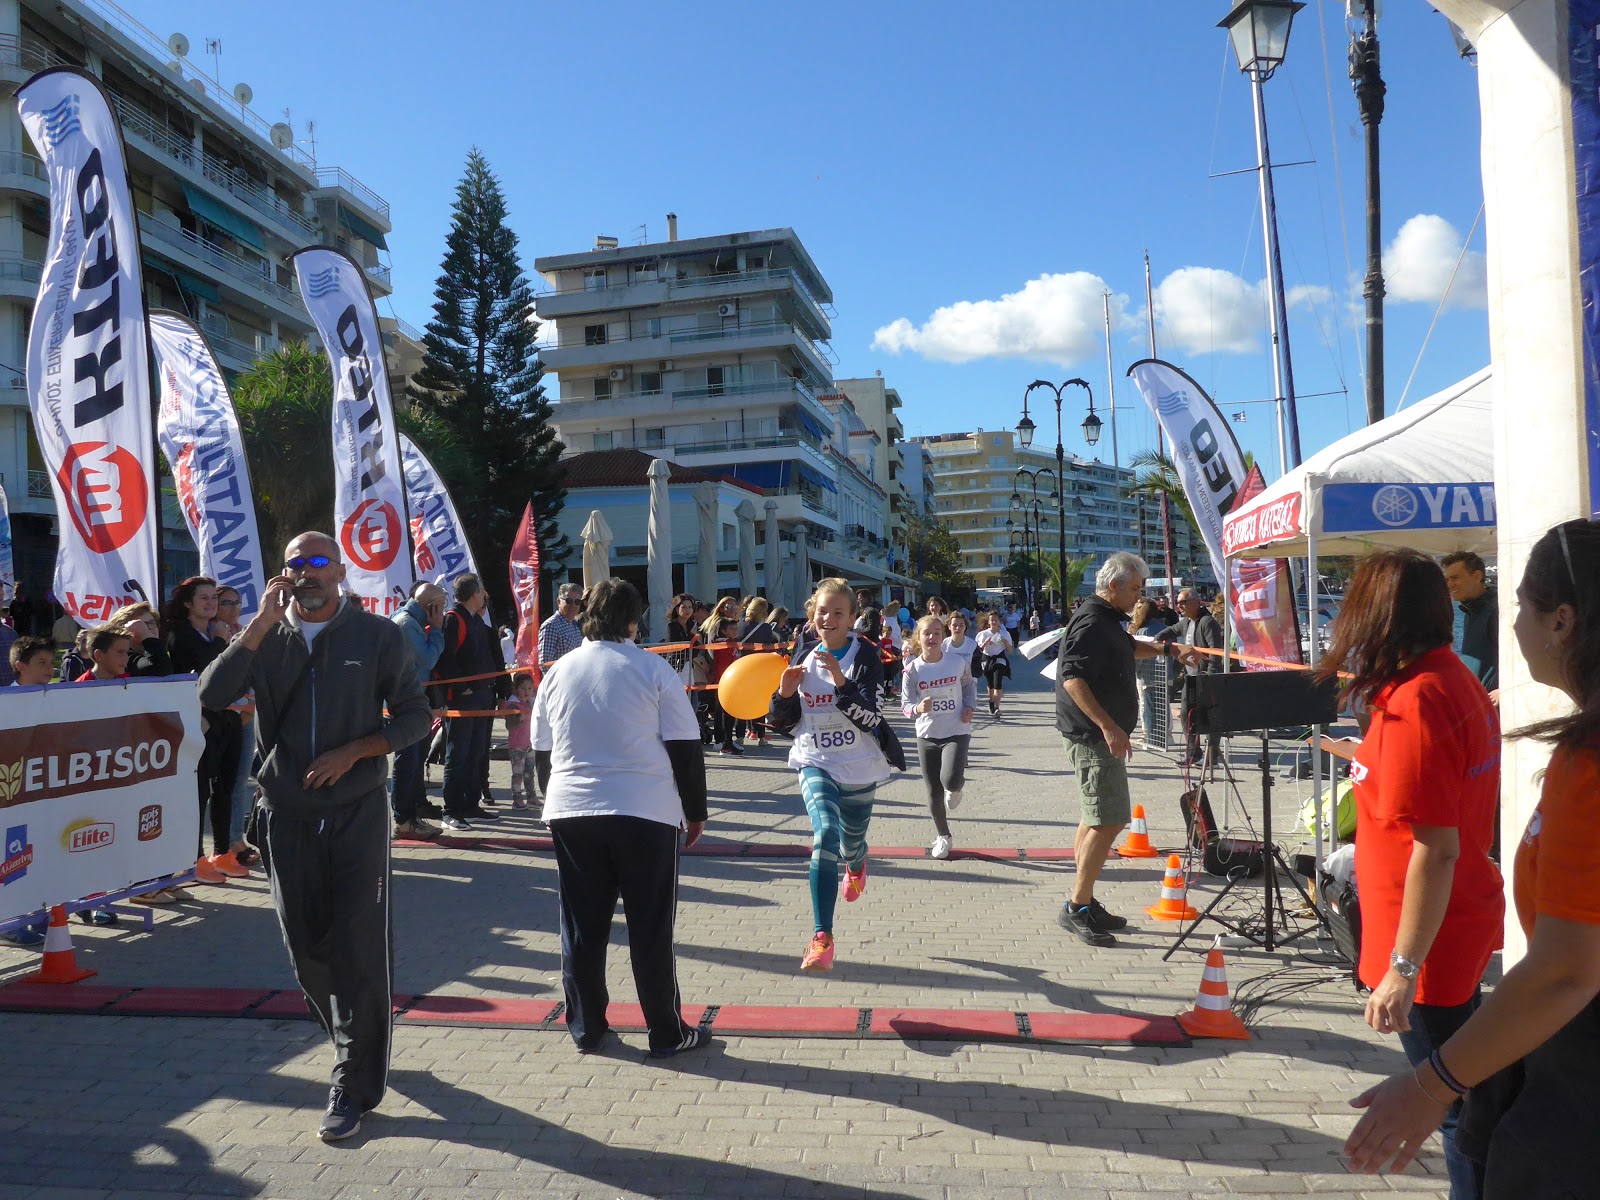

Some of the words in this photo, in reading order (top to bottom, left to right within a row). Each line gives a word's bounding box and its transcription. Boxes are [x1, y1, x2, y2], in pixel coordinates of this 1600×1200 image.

[932, 700, 956, 712] 538
[811, 729, 856, 749] 1589
[25, 738, 171, 792] ELBISCO
[73, 828, 110, 849] Elite
